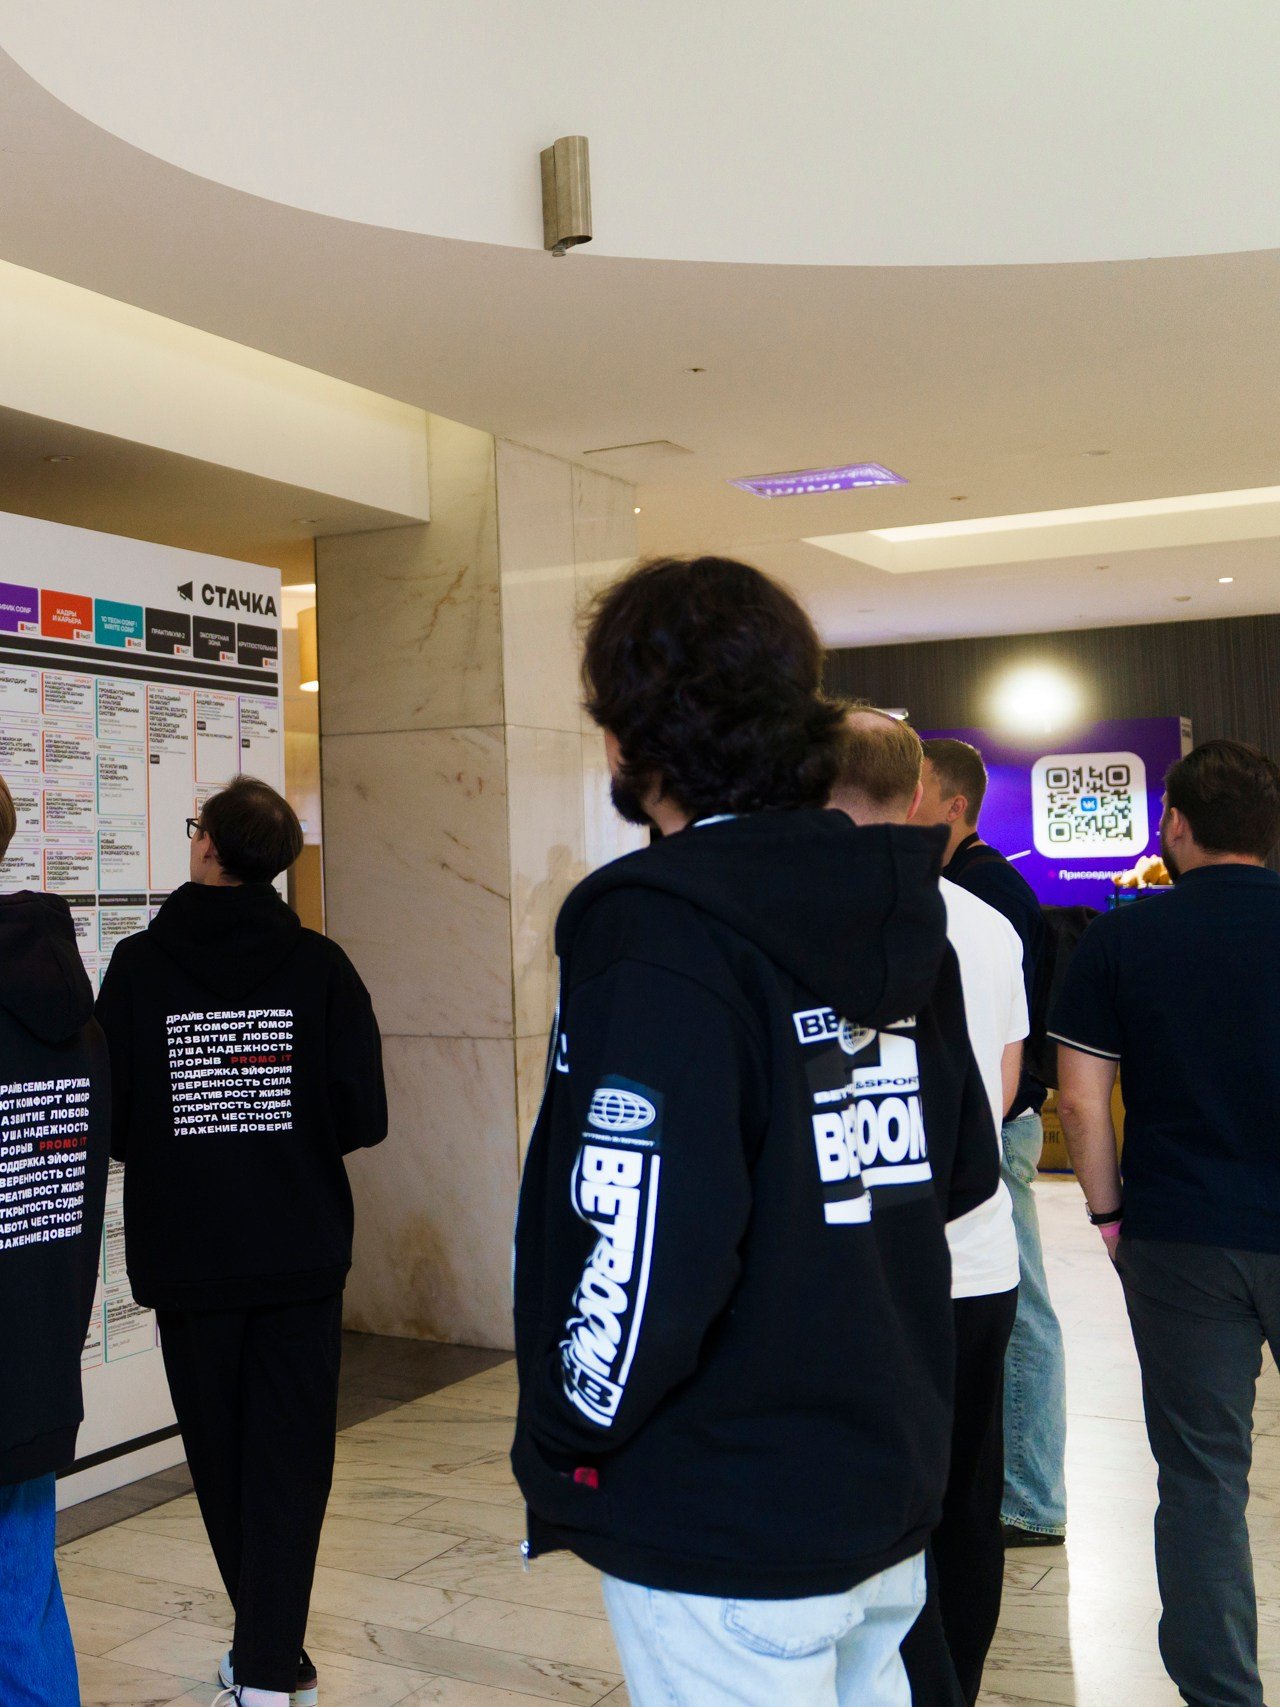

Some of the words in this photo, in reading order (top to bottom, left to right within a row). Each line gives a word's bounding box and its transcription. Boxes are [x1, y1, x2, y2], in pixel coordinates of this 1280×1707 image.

[201, 583, 277, 617] СТАЧКА
[15, 605, 31, 613] CONF
[56, 608, 76, 617] КАДРЫ
[165, 1012, 204, 1024] ДРАЙВ
[205, 1010, 245, 1019] СЕМЬЯ
[247, 1009, 293, 1019] ДРУЖБА
[166, 1024, 190, 1035] УЮТ
[194, 1021, 254, 1031] КОМФОРТ
[258, 1020, 293, 1028] ЮМОР
[167, 1033, 236, 1045] РАЗВИТИЕ
[242, 1031, 293, 1041] ЛЮБОВЬ
[168, 1046, 203, 1058] ДУША
[207, 1043, 292, 1054] НАДЕЖНОСТЬ
[169, 1056, 221, 1068] ПРОРЫВ
[230, 1054, 276, 1064] PROMO
[170, 1067, 239, 1079] ПОДДЕРЖКА
[240, 1065, 292, 1075] ЭЙФОРИЯ
[22, 1080, 54, 1092] СЕМЬЯ
[55, 1077, 90, 1091] ДРУЖБА
[171, 1078, 260, 1091] УВЕРЕННОСТЬ
[262, 1076, 291, 1086] СИЛА
[16, 1094, 62, 1108] КОМФОРТ
[65, 1092, 89, 1103] ЮМОР
[172, 1090, 223, 1101] КРЕАТИВ
[224, 1089, 256, 1098] РОСТ
[258, 1088, 291, 1097] ЖИЗНЬ
[50, 1107, 89, 1119] ЛЮБОВЬ
[172, 1101, 251, 1113] ОТКРЫТОСТЬ
[253, 1099, 291, 1110] СУДЬБА
[174, 1113, 218, 1124] ЗАБОТА
[221, 1110, 292, 1120] ЧЕСТНОСТЬ
[23, 1122, 88, 1138] НАДЕЖНОСТЬ
[173, 1123, 238, 1136] УВАЖЕНИЕ
[239, 1121, 292, 1132] ДОВЕРИЕ
[39, 1137, 77, 1151] PROMO
[80, 1136, 87, 1147] IT
[47, 1150, 86, 1164] ЭЙФОРИЯ
[65, 1165, 85, 1177] СИЛА
[33, 1183, 59, 1197] РОСТ
[60, 1180, 84, 1193] ЖИЗНЬ
[55, 1195, 83, 1209] СУДЬБА
[30, 1210, 82, 1227] ЧЕСТНОСТЬ
[41, 1223, 82, 1242] ДОВЕРИЕ
